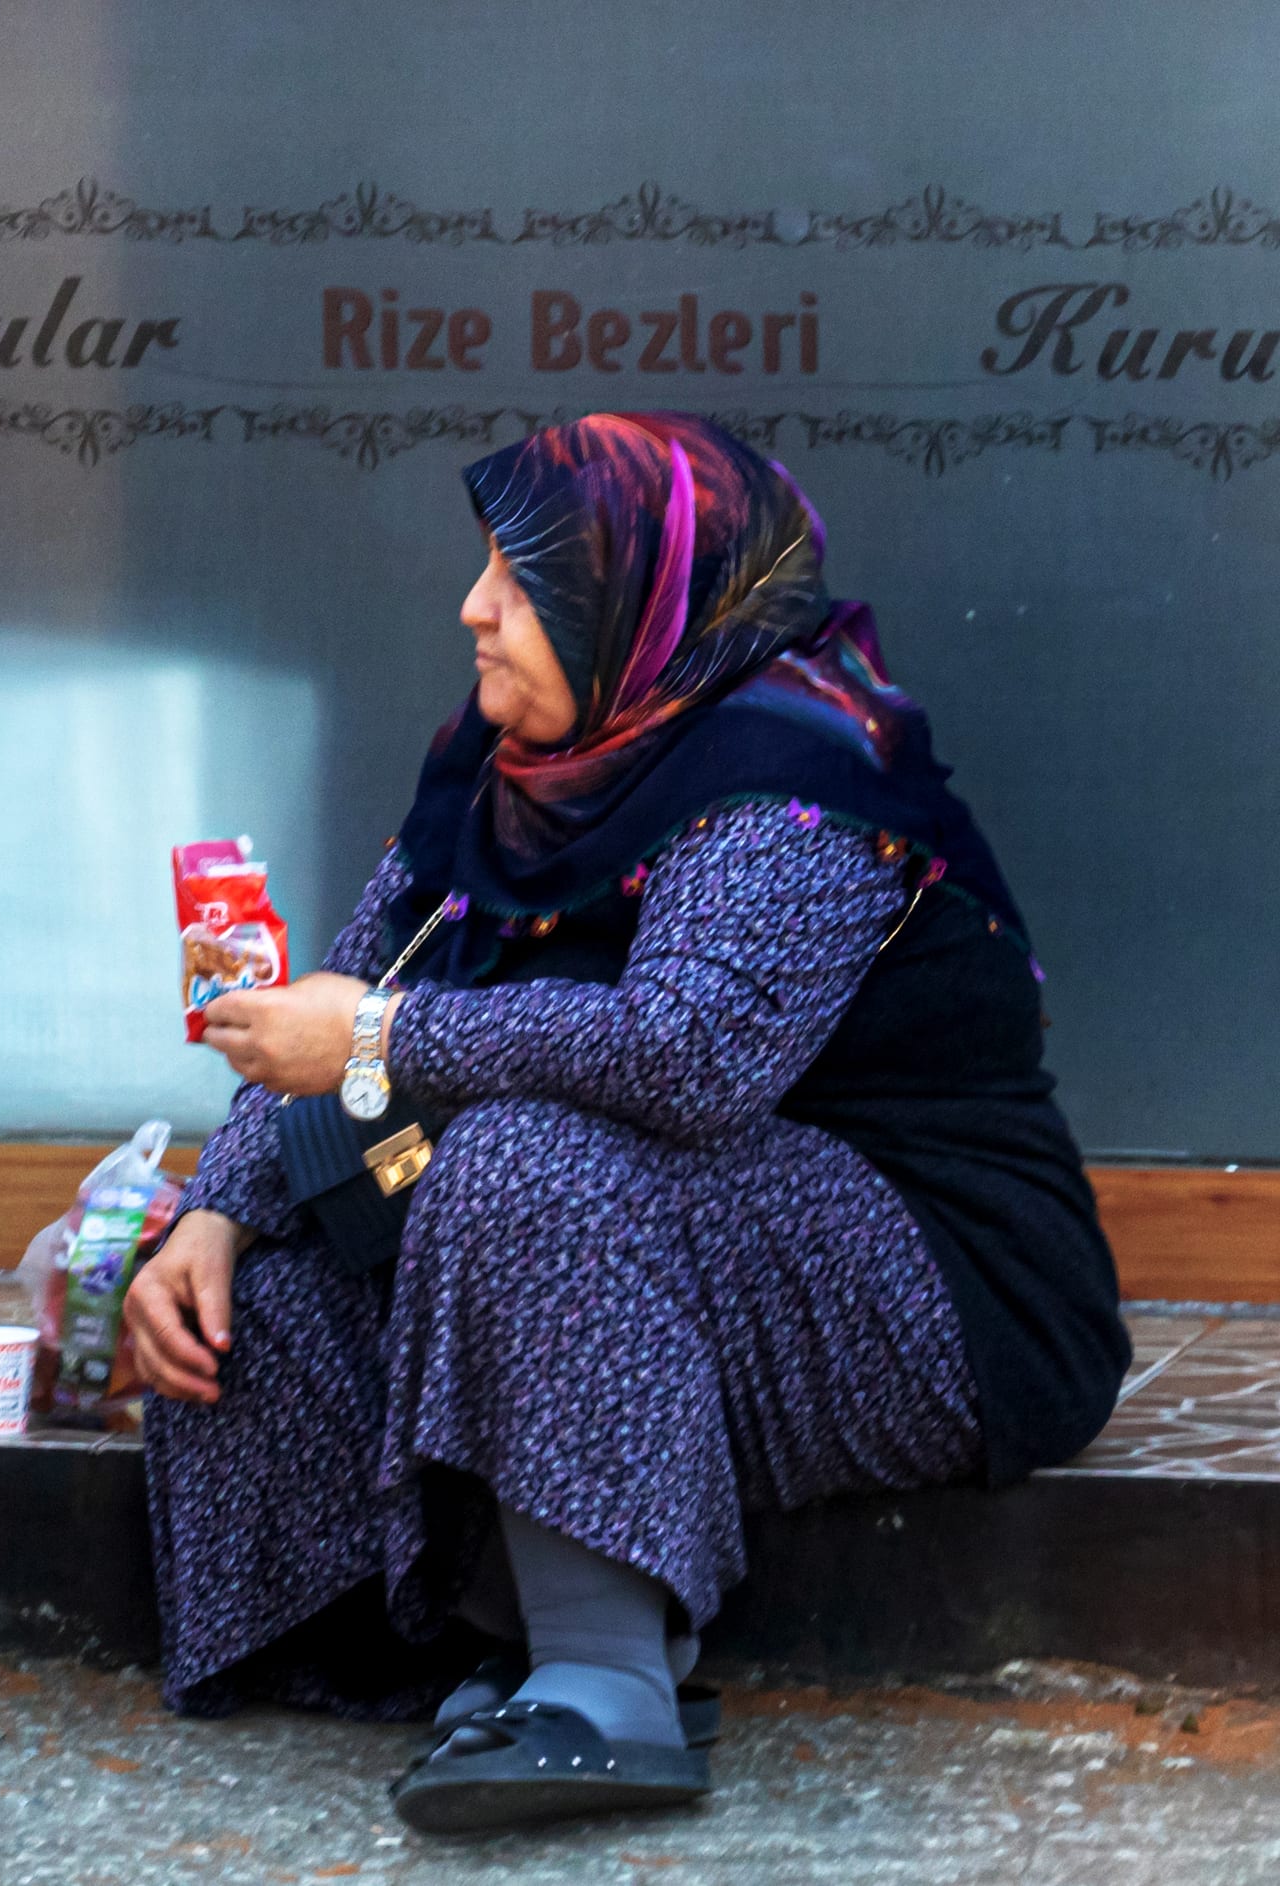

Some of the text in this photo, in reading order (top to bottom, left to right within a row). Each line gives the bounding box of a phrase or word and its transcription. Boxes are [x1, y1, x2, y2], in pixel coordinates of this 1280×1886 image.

[322, 287, 819, 377] Rize Bezleri
[979, 282, 1280, 383] Kuru
